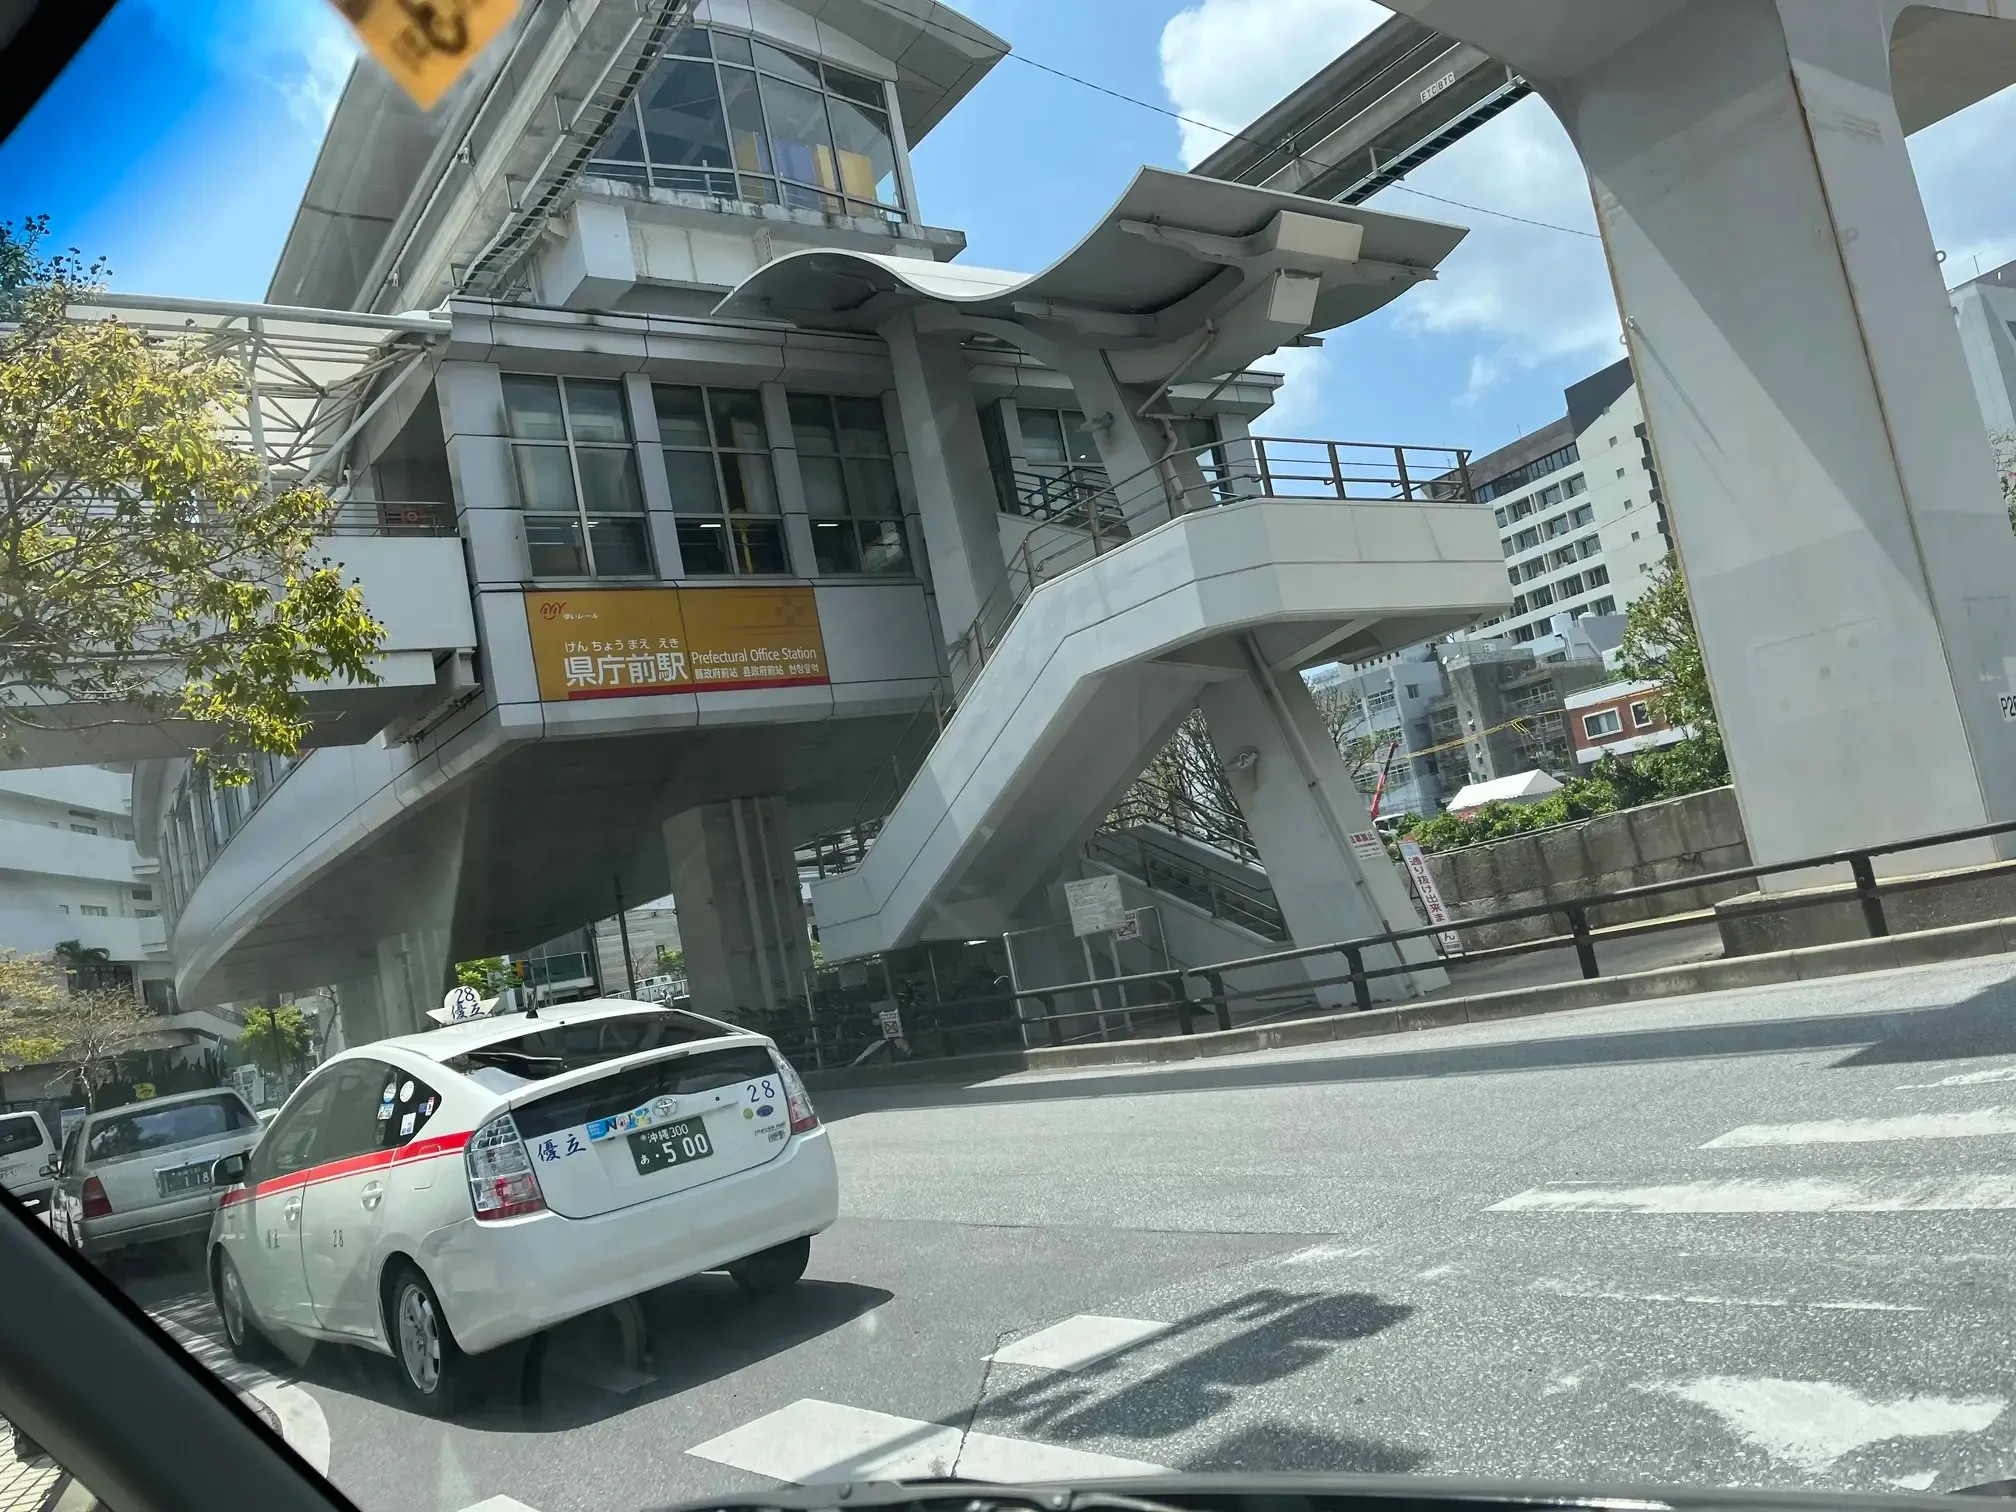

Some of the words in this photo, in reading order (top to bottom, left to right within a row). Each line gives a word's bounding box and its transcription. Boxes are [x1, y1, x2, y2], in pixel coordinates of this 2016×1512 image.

[565, 641, 588, 653] けん
[591, 639, 624, 651] ちょう
[628, 638, 650, 650] まえ
[658, 637, 679, 649] えき
[691, 648, 748, 664] Prefectural
[750, 647, 780, 662] Office
[781, 646, 817, 660] Station
[564, 652, 688, 687] 県庁前駅
[1410, 857, 1455, 941] 通り抜け出来まん
[455, 987, 475, 1001] 28
[746, 1080, 775, 1103] 28
[537, 1133, 586, 1162] 優立
